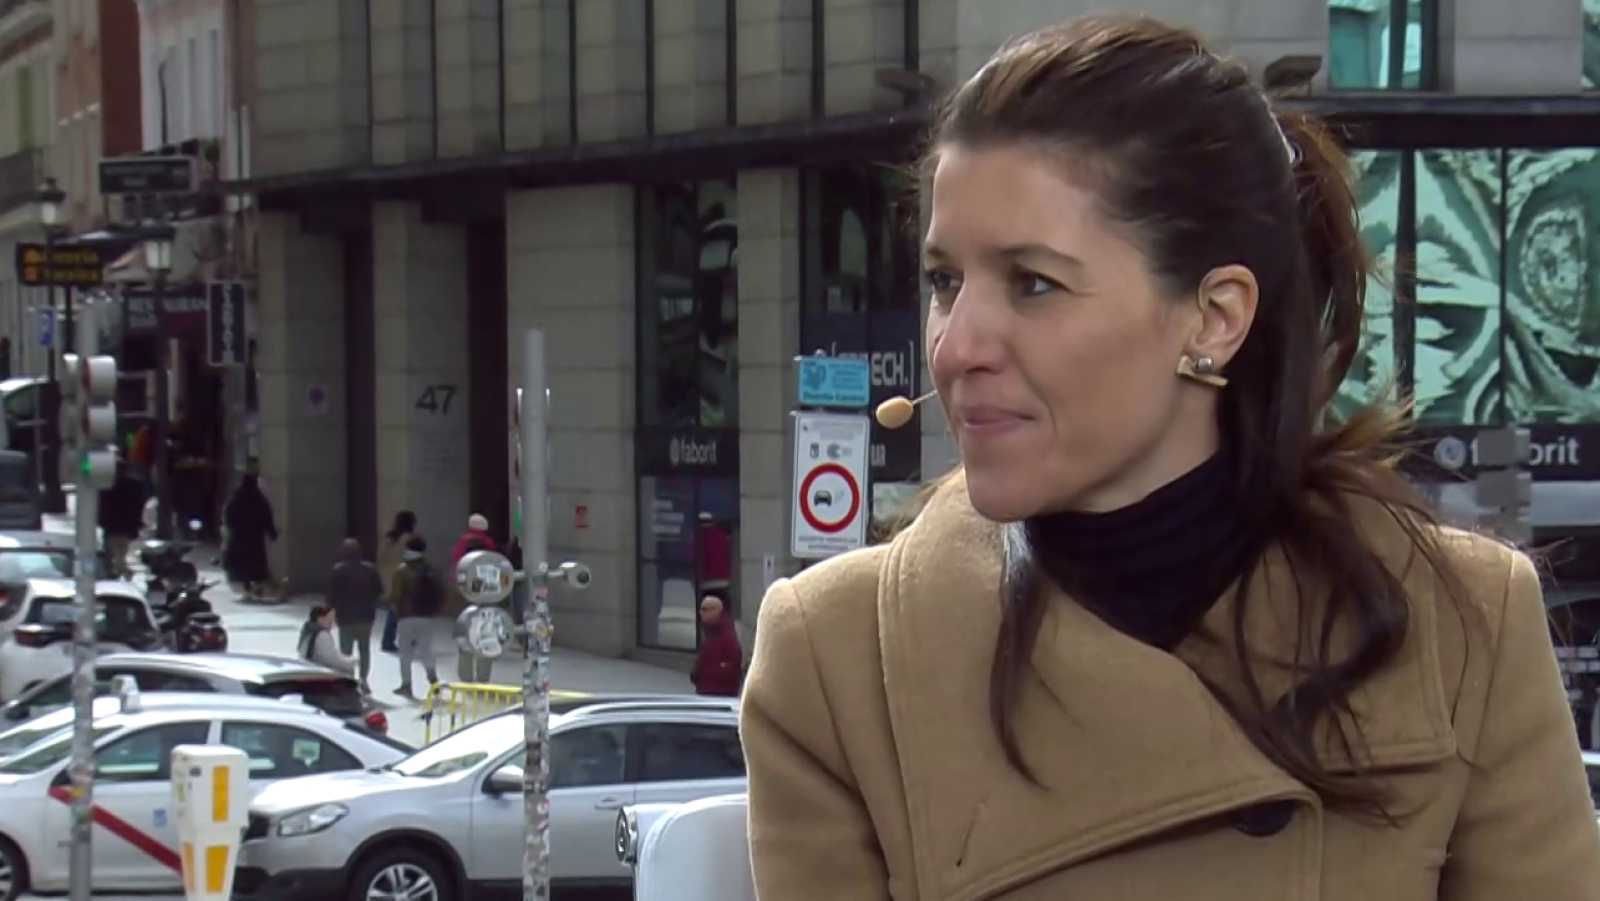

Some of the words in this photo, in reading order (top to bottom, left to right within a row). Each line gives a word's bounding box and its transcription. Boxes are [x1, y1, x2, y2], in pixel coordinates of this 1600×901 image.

[415, 384, 457, 415] 47
[680, 436, 717, 464] faborit
[1470, 437, 1580, 466] forit
